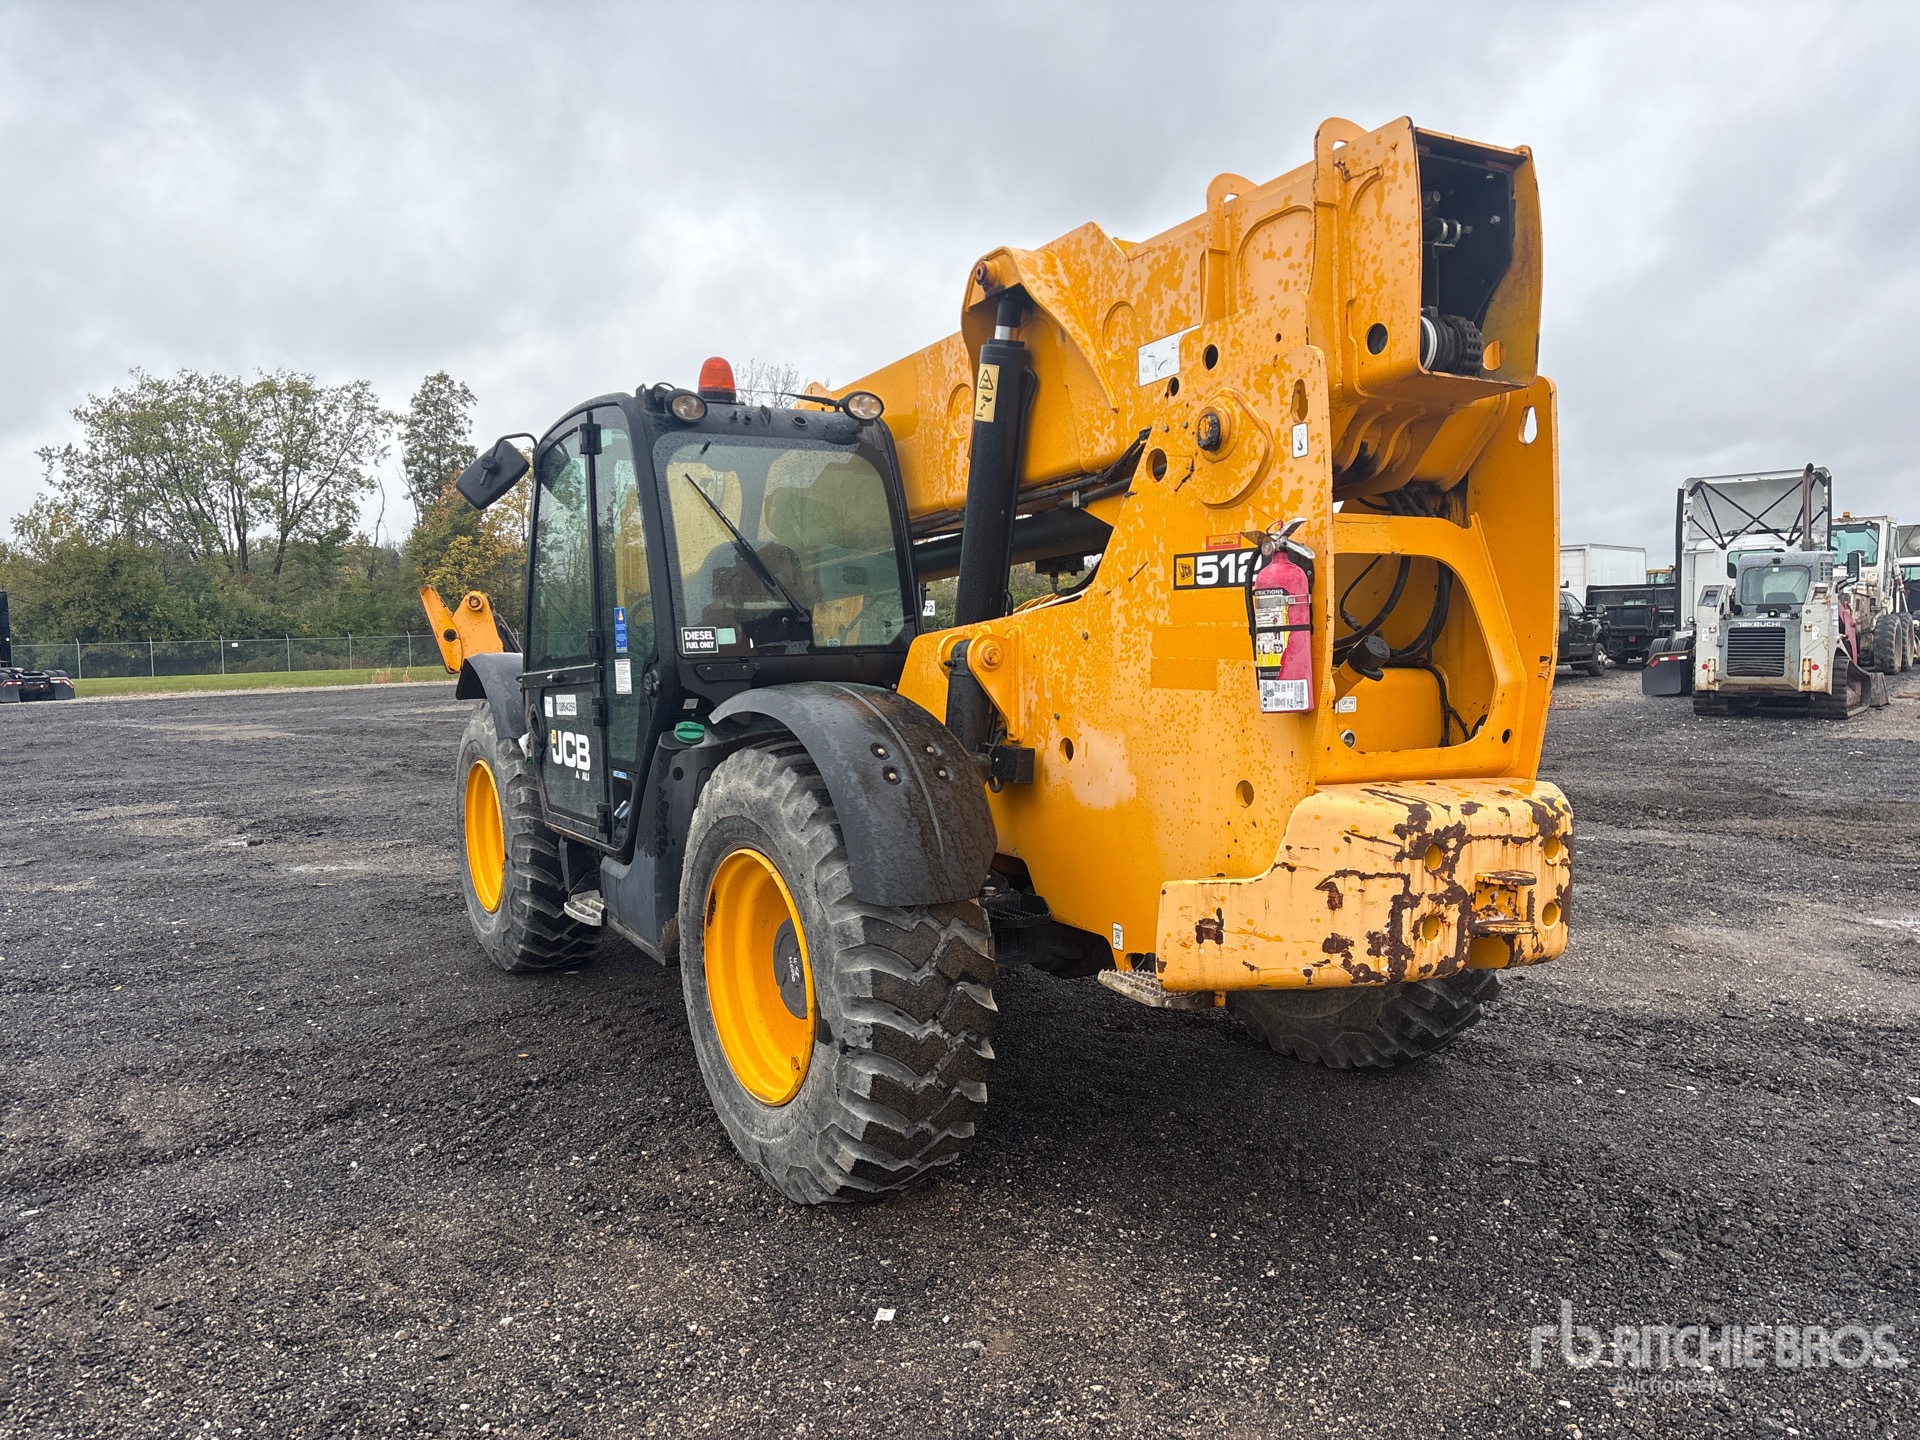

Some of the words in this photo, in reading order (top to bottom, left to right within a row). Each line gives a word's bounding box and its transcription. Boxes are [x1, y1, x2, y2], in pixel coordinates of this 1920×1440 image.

[684, 631, 714, 641] DIESEL
[686, 641, 699, 649] FUEL
[699, 641, 715, 649] ONLY
[551, 730, 591, 771] JCB
